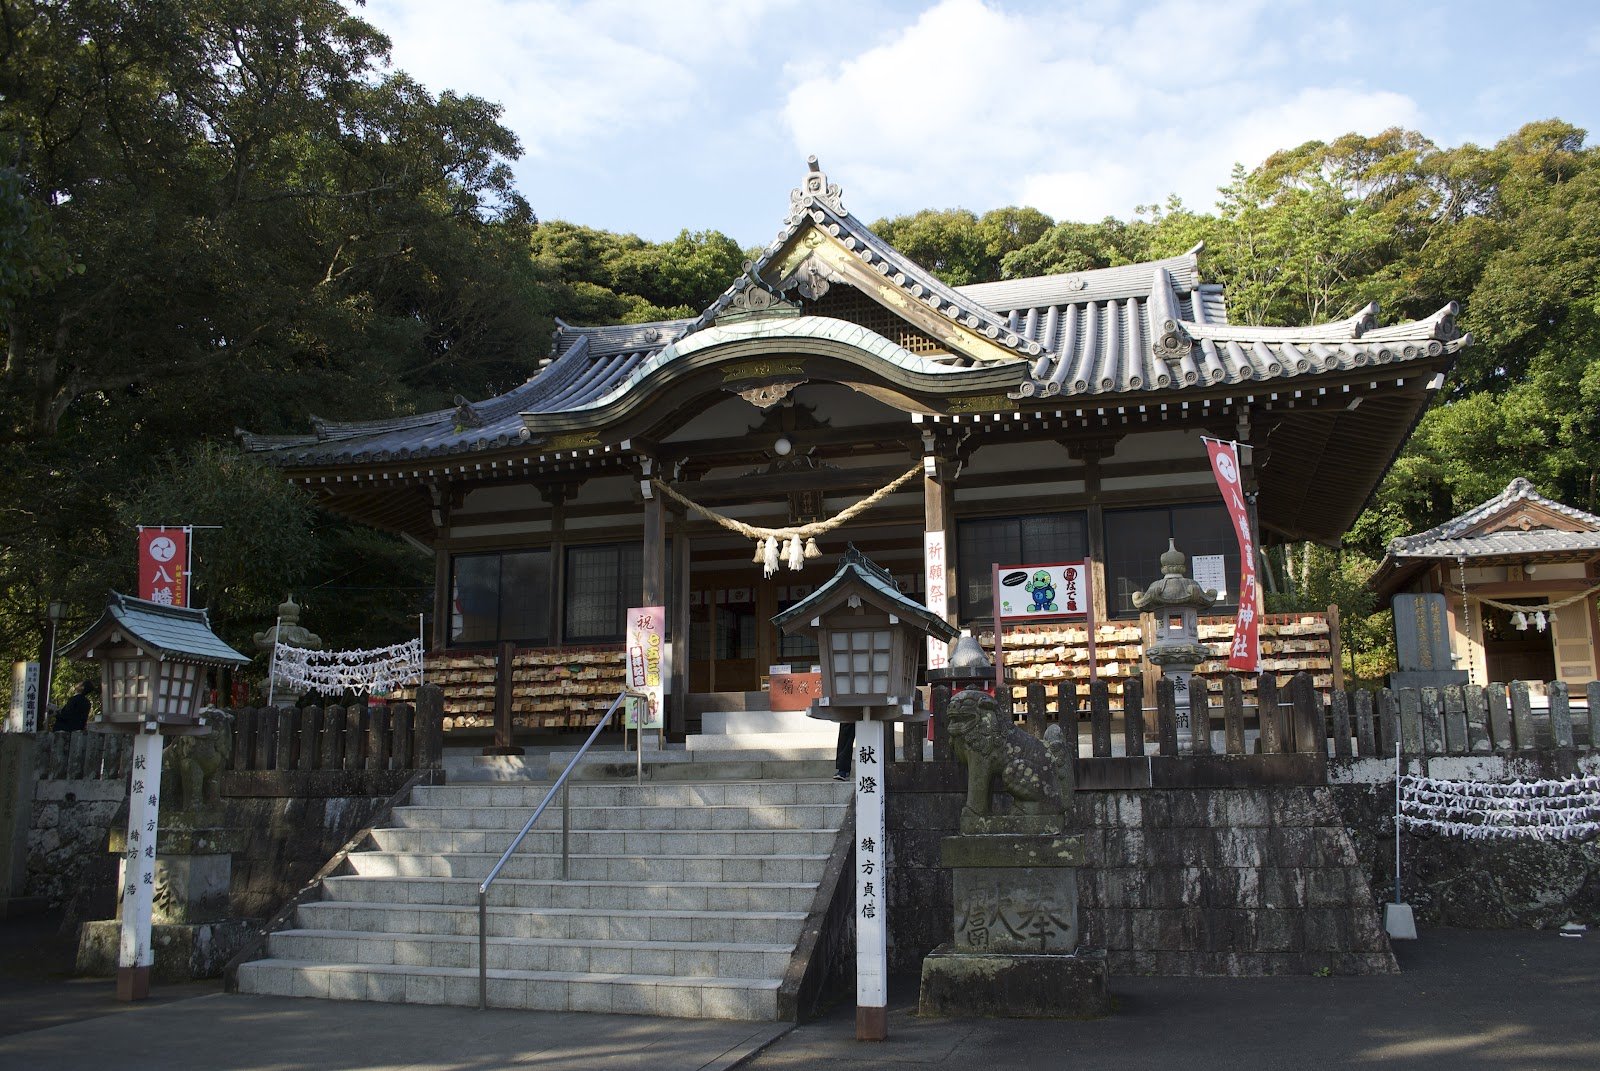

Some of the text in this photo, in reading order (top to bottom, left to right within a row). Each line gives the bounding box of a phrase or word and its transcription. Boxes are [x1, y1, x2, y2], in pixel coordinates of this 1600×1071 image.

[928, 542, 946, 669] 祈願祭付中
[1231, 487, 1257, 659] 八幡竈門神社
[637, 615, 655, 630] 祝
[1173, 676, 1190, 729] 奉納
[132, 754, 146, 794] 献燈
[143, 794, 158, 885] 緒方建設
[858, 745, 877, 919] 献燈 緒方貞信
